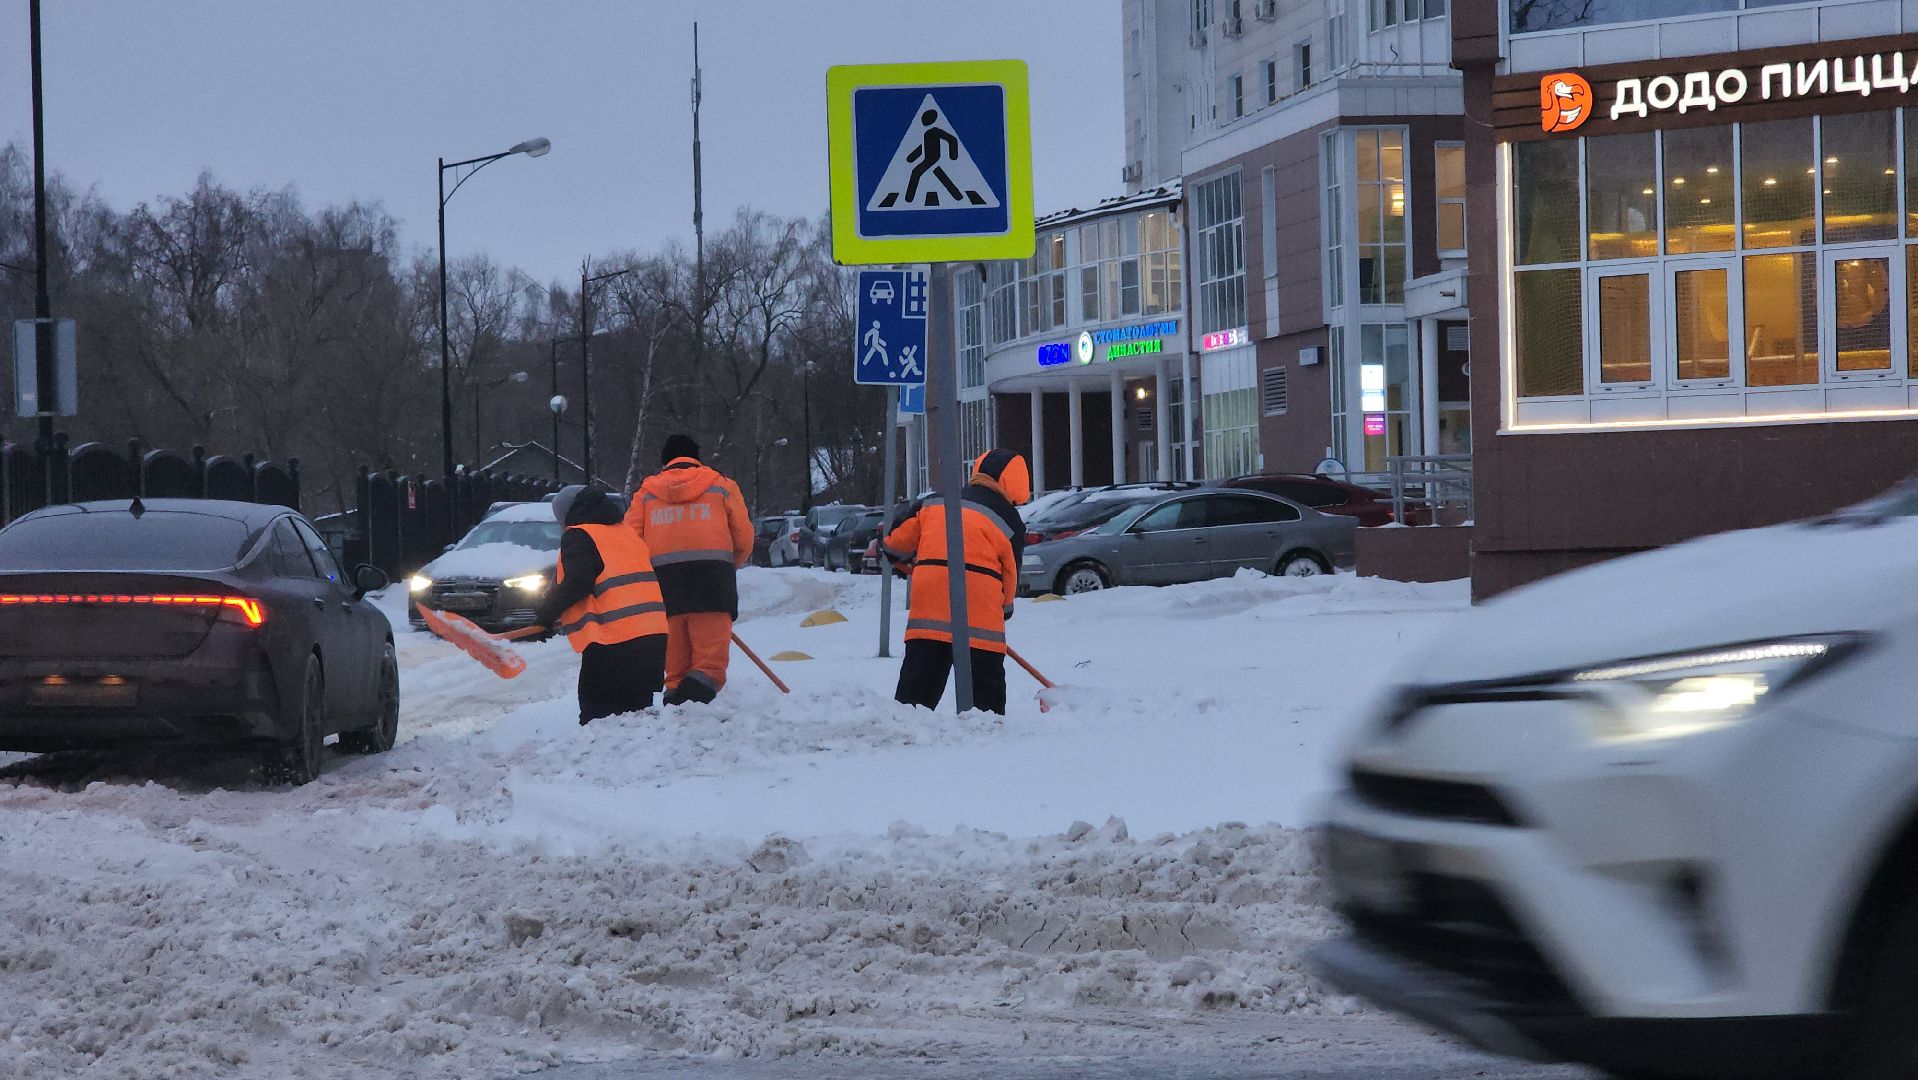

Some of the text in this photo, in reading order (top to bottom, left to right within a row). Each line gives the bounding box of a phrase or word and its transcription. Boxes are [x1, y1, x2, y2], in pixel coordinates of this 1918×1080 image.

[1610, 68, 1748, 120] ДОДО
[1093, 320, 1177, 345] СТОМАТОЛОГИЯ
[1038, 343, 1070, 366] OZON
[1107, 339, 1162, 361] ДИНАСТИЯ
